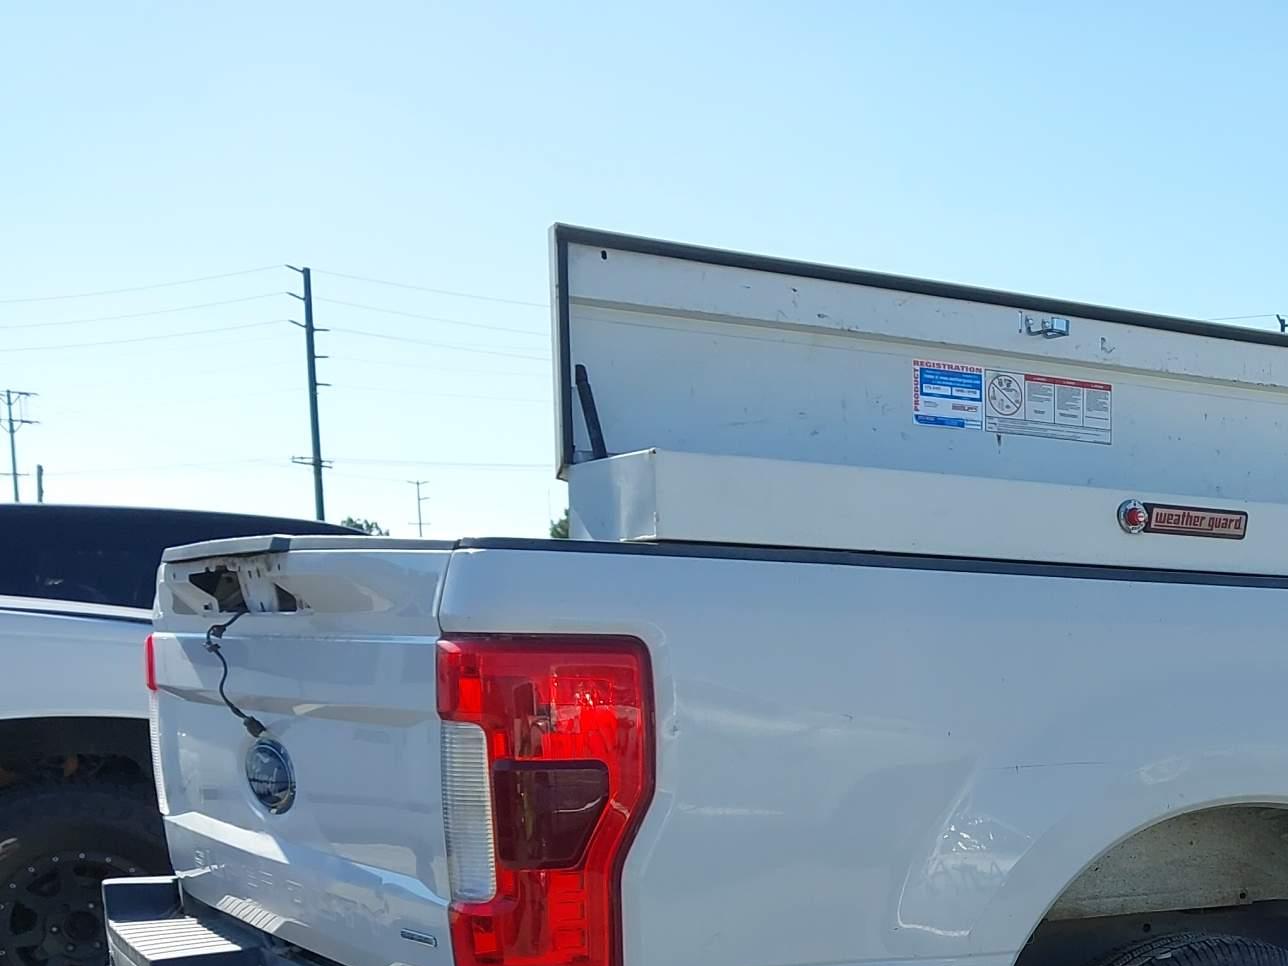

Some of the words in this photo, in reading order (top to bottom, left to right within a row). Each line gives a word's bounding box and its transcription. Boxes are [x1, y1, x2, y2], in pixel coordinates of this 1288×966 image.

[912, 360, 982, 373] REGISTRATION
[1155, 511, 1206, 527] weather
[1208, 515, 1242, 531] guard
